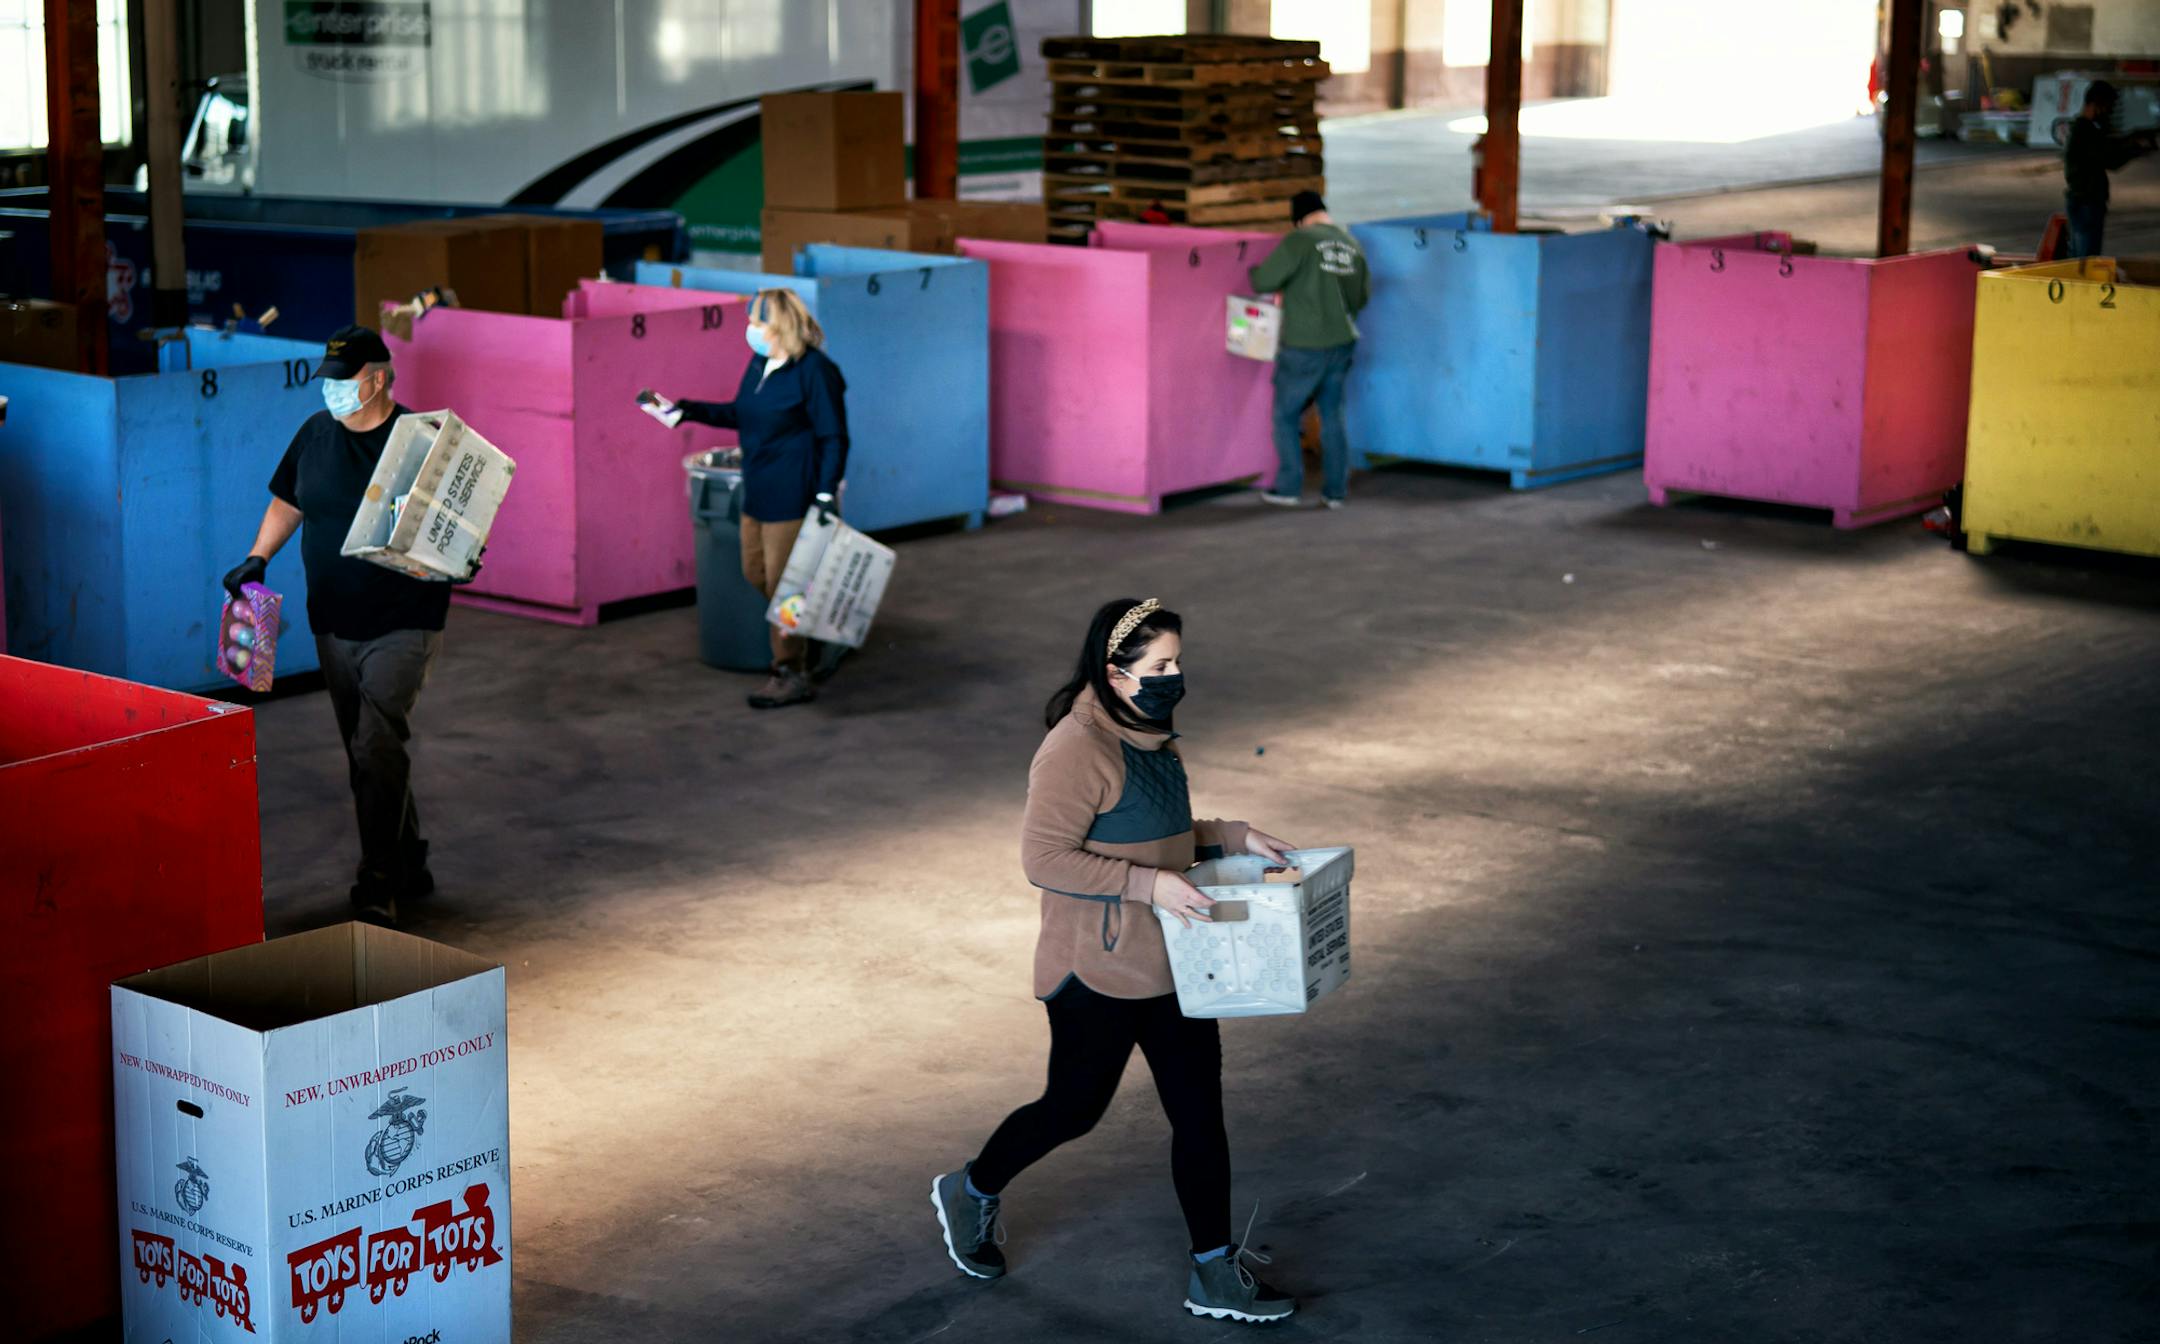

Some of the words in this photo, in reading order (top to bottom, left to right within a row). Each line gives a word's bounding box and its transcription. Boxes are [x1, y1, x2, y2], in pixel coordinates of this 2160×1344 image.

[288, 8, 429, 43] enterprise
[306, 51, 354, 71] truck
[1188, 245, 1201, 268] 6
[1236, 240, 1248, 261] 7
[1414, 228, 1426, 251] 3
[1454, 229, 1466, 253] 5
[867, 273, 881, 296] 6
[919, 266, 933, 290] 7
[1710, 246, 1724, 273] 3
[1779, 252, 1793, 278] 5
[2047, 278, 2064, 305] 0
[2100, 282, 2116, 309] 2
[631, 313, 646, 339] 8
[701, 304, 722, 331] 10
[201, 368, 218, 399] 8
[283, 358, 310, 390] 10
[448, 453, 474, 498] STATES
[459, 454, 487, 508] SERVICE
[120, 1052, 143, 1071] NEW,
[145, 1059, 201, 1088] UNWRAPPED
[201, 1079, 224, 1098] TOYS
[225, 1088, 250, 1107] ONLY
[285, 1085, 324, 1108] NEW,
[328, 1057, 418, 1096] UNWRAPPED
[420, 1045, 455, 1068] TOYS
[457, 1032, 495, 1057] ONLY
[289, 1210, 317, 1228] U.S.
[321, 1189, 382, 1220] MARINE
[385, 1171, 434, 1198] CORPS
[436, 1148, 500, 1181] RESERVE
[131, 1201, 148, 1215] U.S.
[150, 1207, 186, 1228] MARINE
[187, 1221, 215, 1240] CORPS
[216, 1233, 253, 1257] RESERVE
[295, 1244, 357, 1294] TOYS
[369, 1239, 415, 1274] FOR
[428, 1216, 486, 1255] TOTS
[135, 1240, 171, 1271] TOYS
[179, 1256, 204, 1292] FOR
[212, 1275, 246, 1316] TOTS
[403, 1328, 441, 1344] Rock
